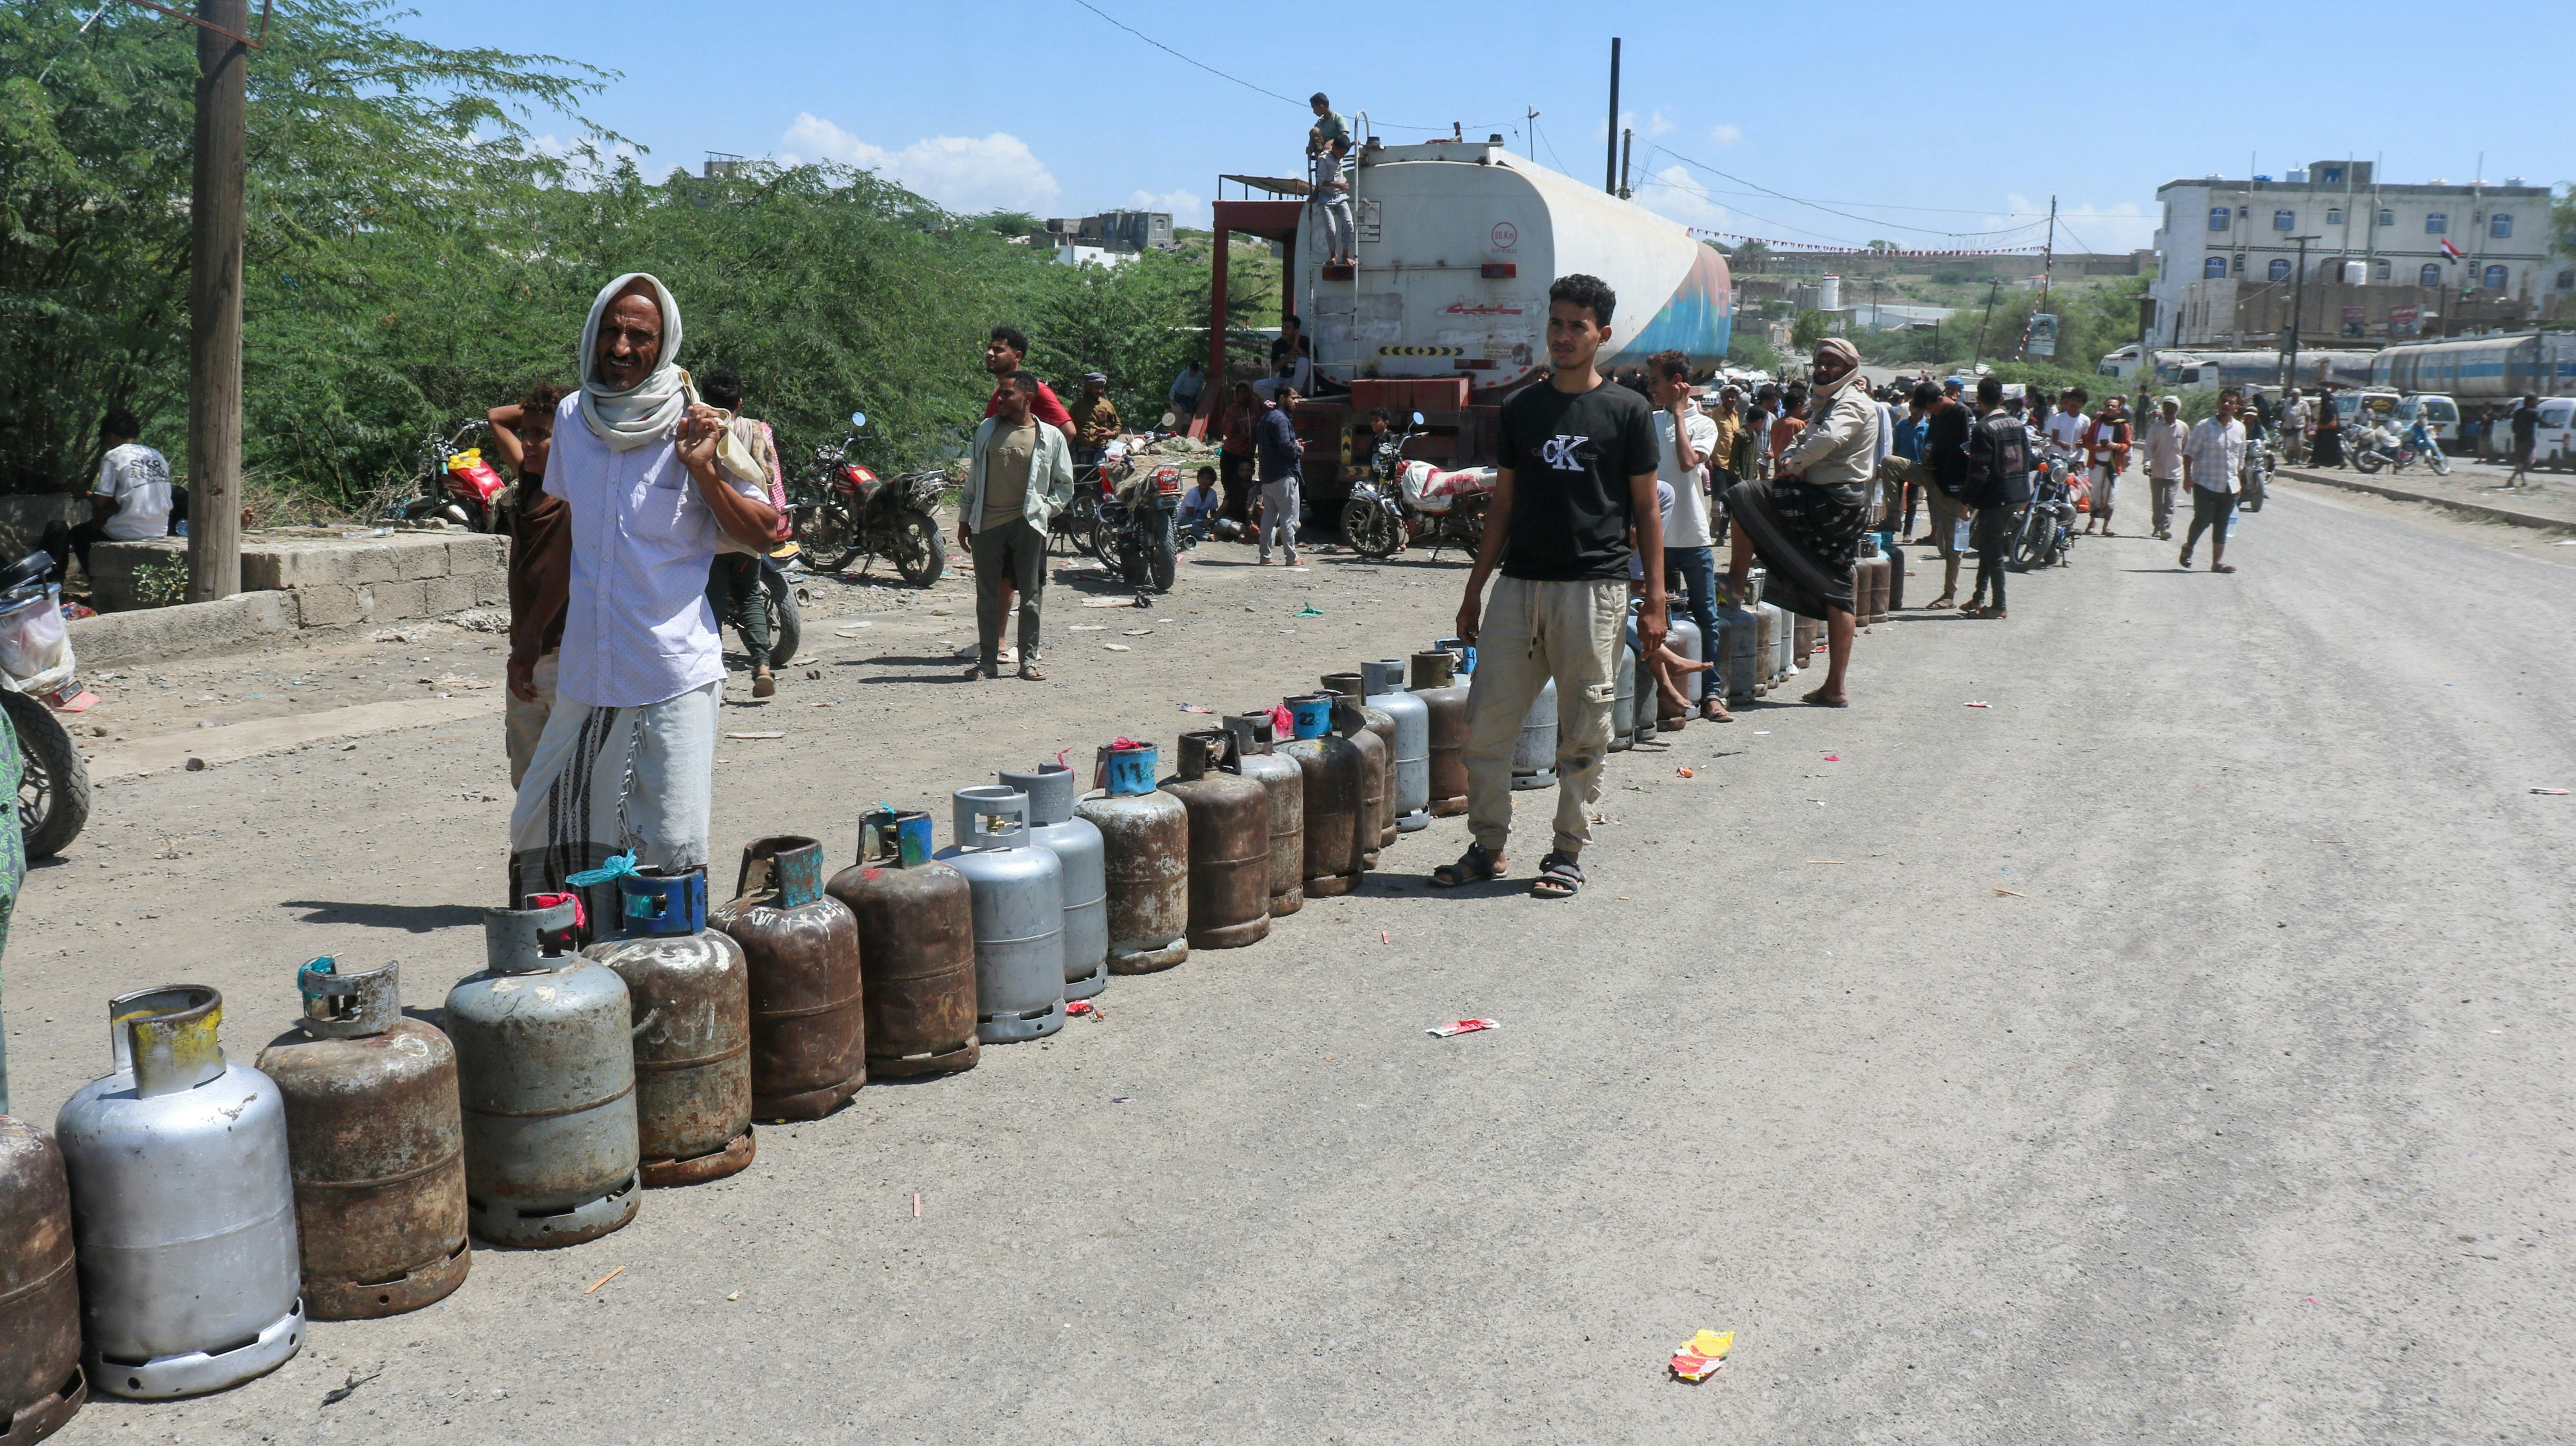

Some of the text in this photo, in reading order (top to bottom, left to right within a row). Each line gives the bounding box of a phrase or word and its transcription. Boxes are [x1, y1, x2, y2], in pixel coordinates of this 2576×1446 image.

[1495, 230, 1515, 240] 80 Km
[1299, 712, 1315, 726] 22
